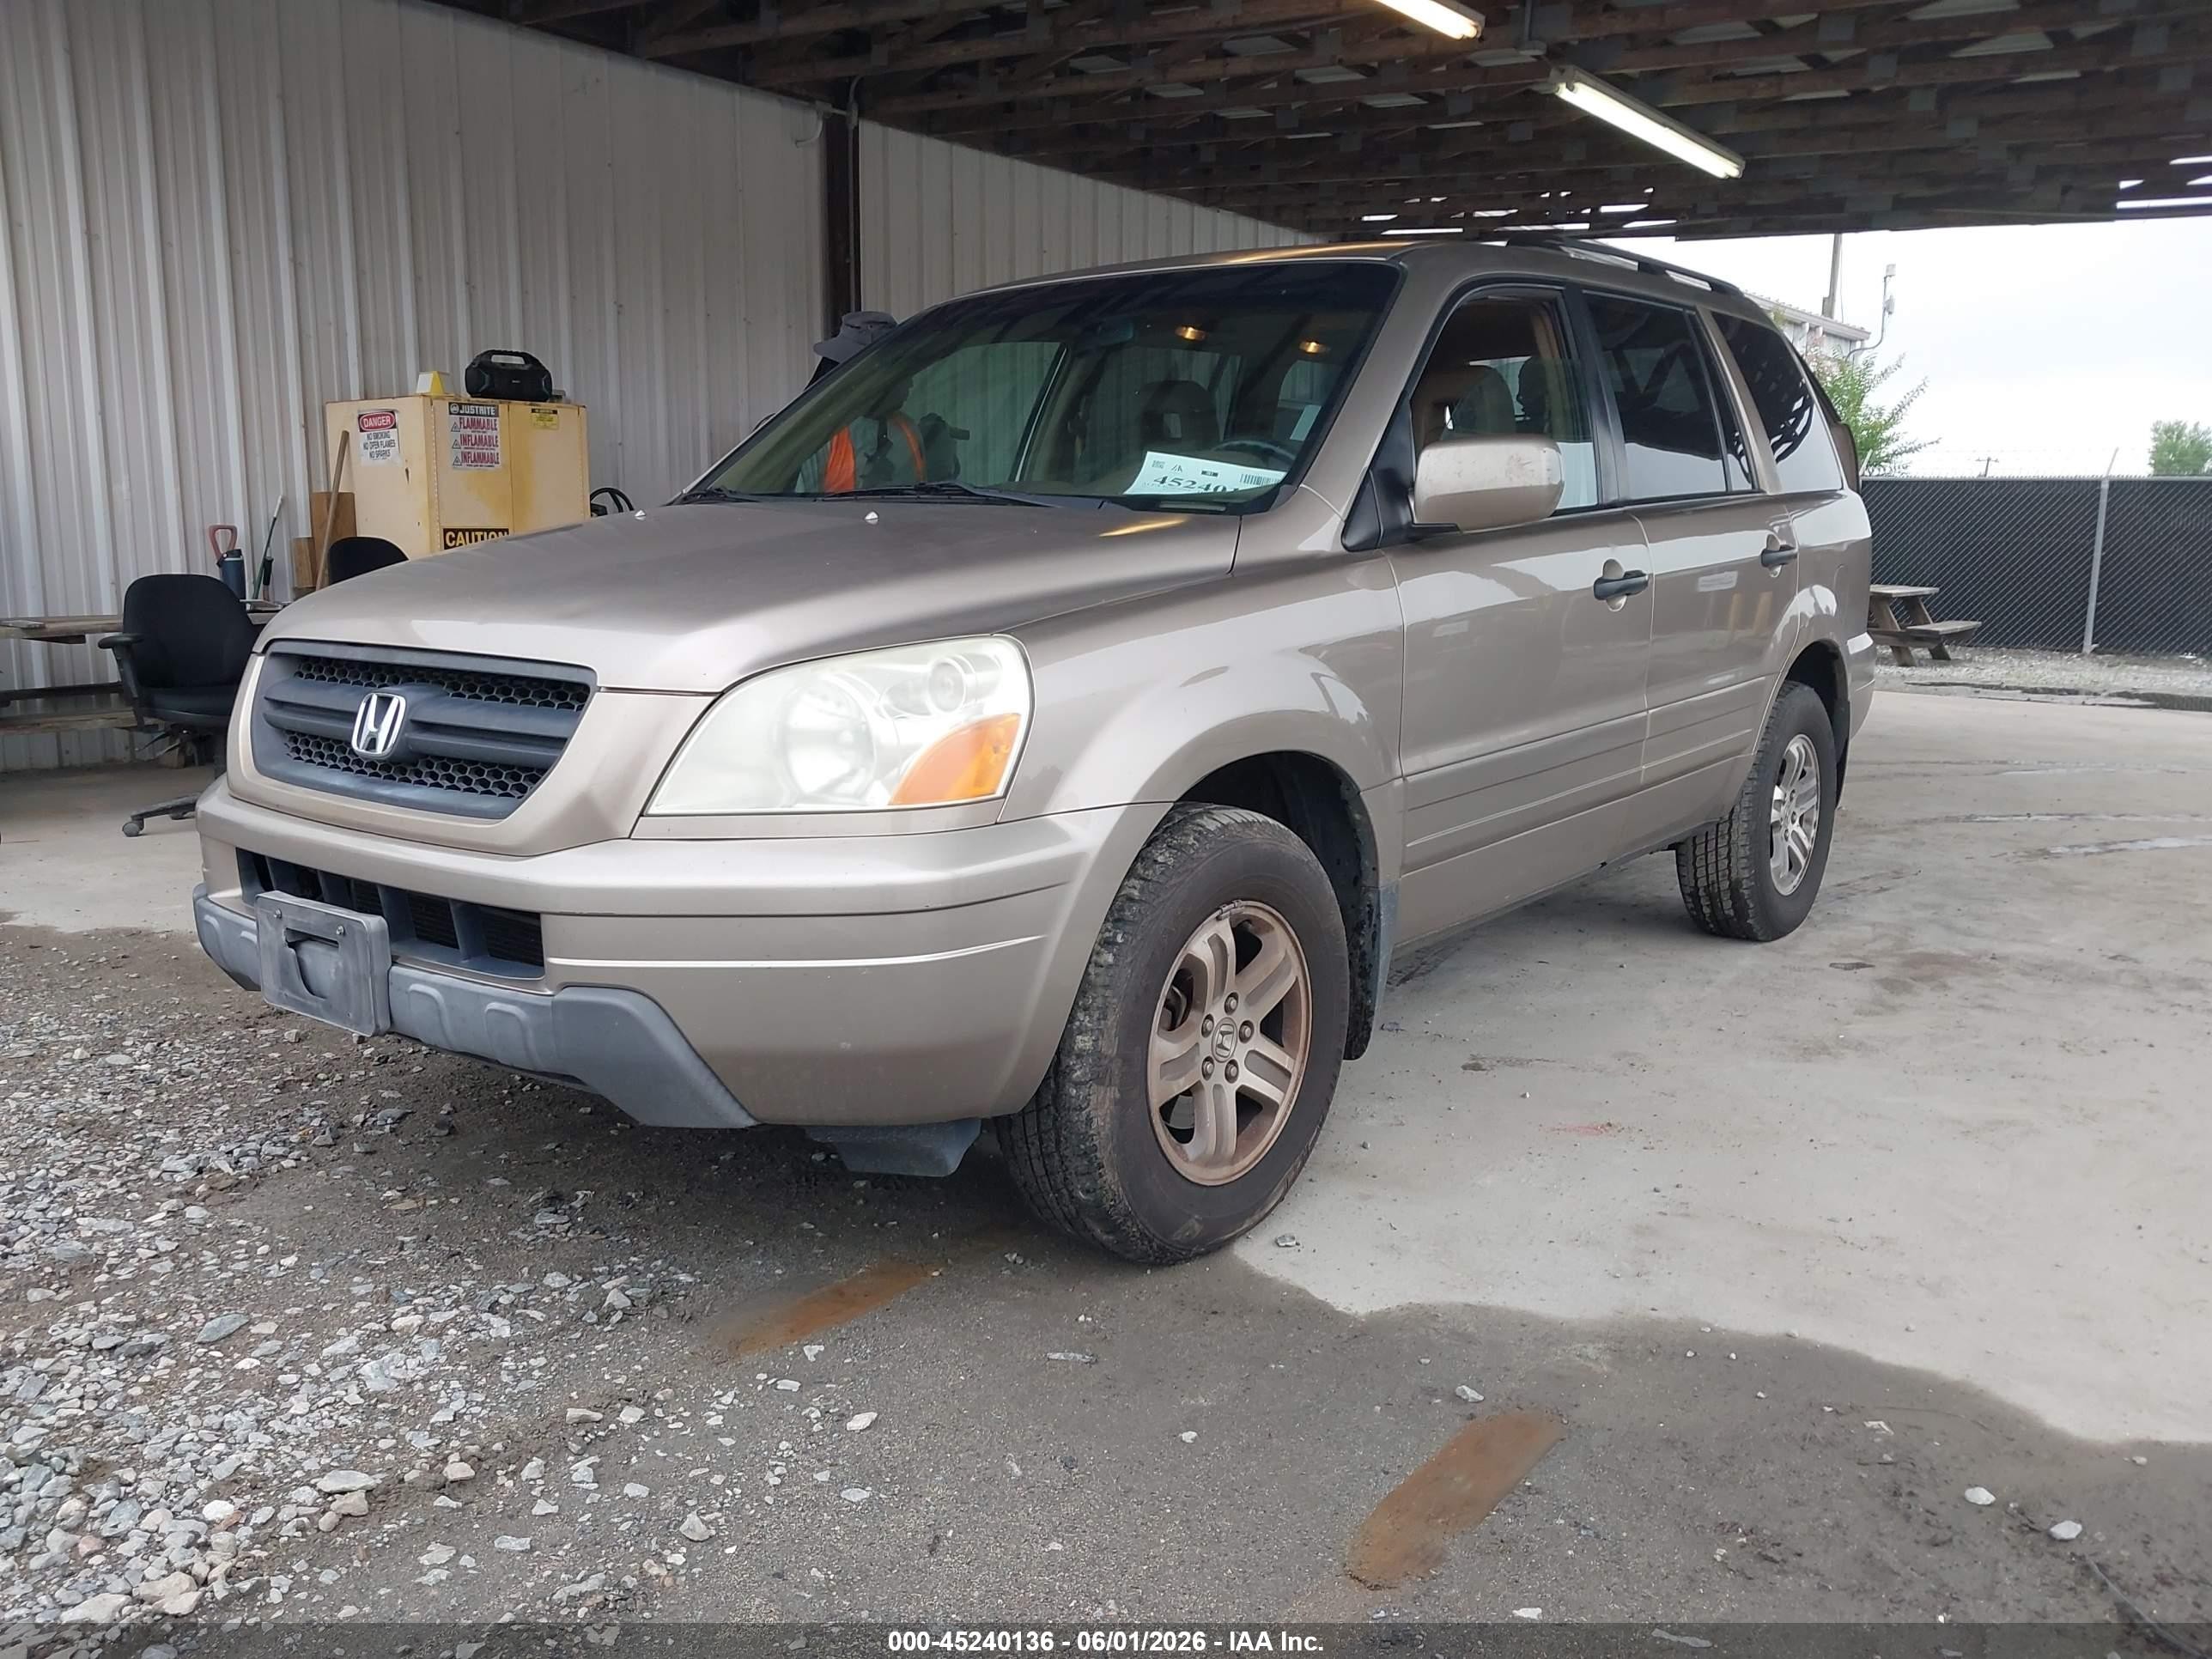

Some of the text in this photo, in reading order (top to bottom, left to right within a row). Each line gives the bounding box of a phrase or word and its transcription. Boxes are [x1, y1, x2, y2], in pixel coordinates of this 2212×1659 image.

[459, 404, 495, 416] JUSTRITE
[362, 416, 392, 428] DANGER
[459, 416, 498, 431] FLAMMABLE
[459, 434, 499, 447] INFLAMABLE
[460, 451, 500, 465] INFLAMMABLE
